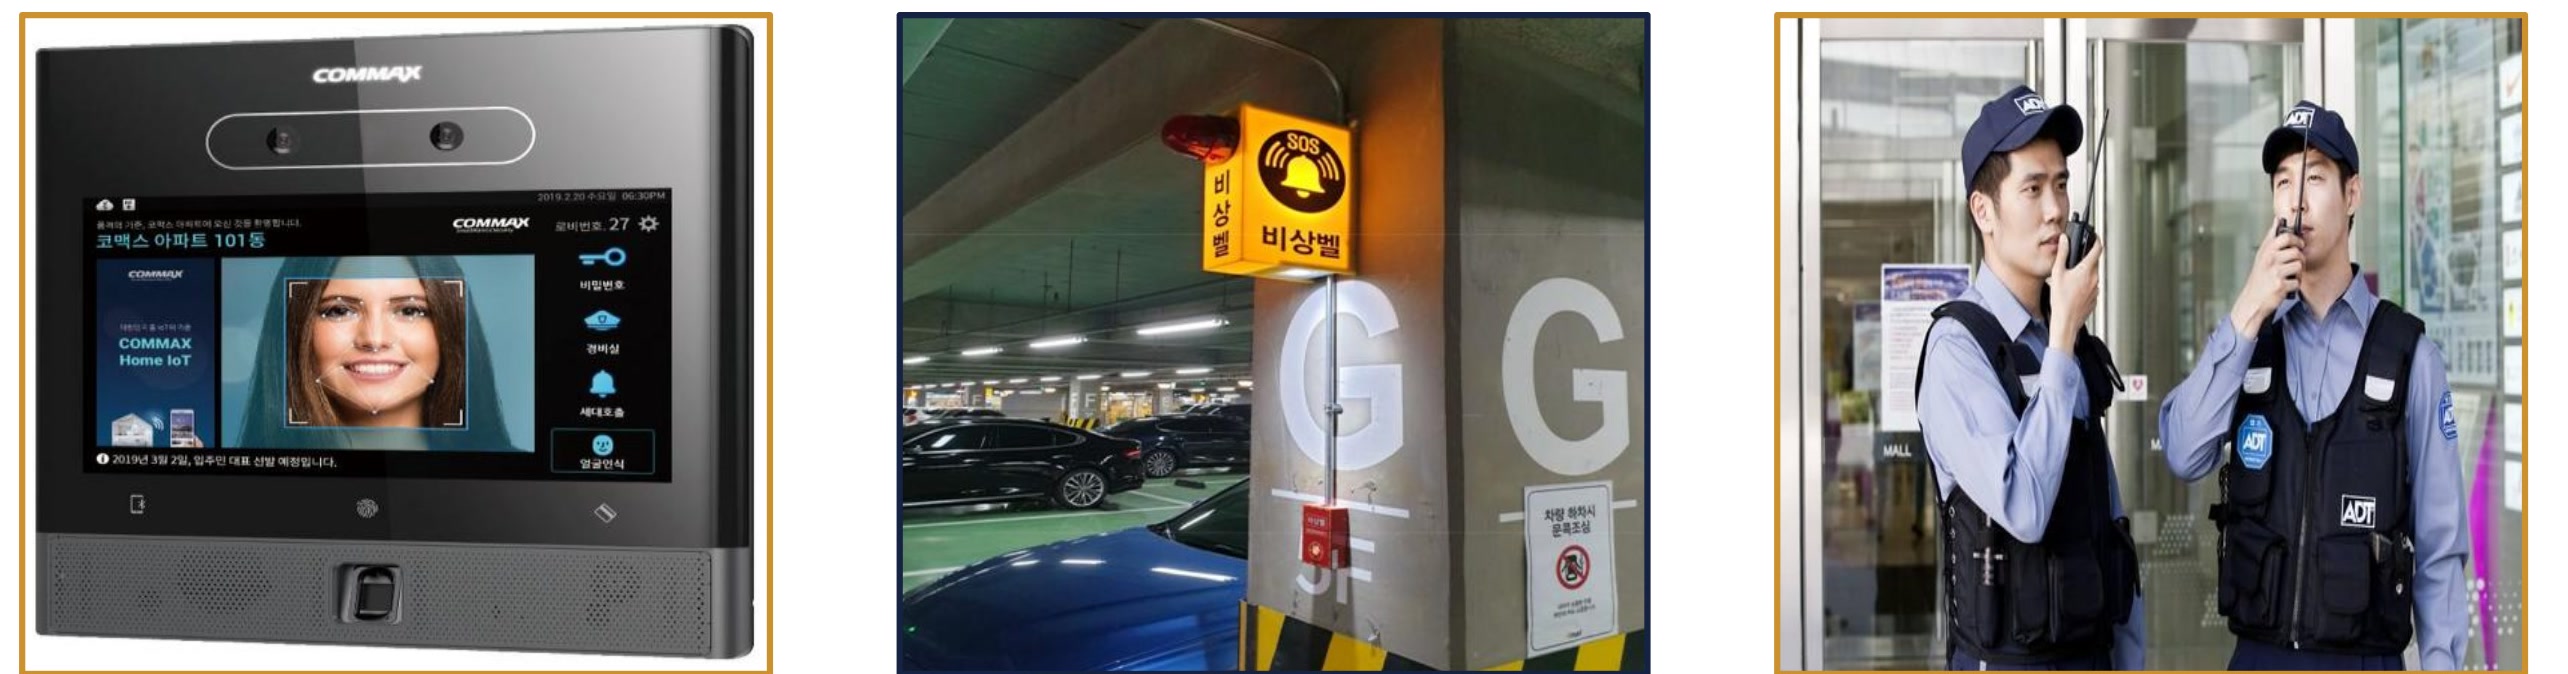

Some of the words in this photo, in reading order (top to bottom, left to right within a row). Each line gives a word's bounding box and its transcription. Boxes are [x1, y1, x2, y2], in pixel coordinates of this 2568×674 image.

[312, 66, 423, 83] COMMAX
[2285, 111, 2313, 126] ADT
[1286, 132, 1321, 155] SOS
[621, 191, 666, 200] 06:30PM
[1212, 169, 1231, 258] 비상벨
[453, 217, 530, 229] COMMAX
[609, 217, 630, 231] 27
[96, 233, 150, 250] 코맥스
[154, 233, 208, 249] 아파트
[214, 232, 266, 248] 101동
[1262, 225, 1340, 259] 비상벨
[128, 269, 184, 279] COMMAX
[580, 280, 626, 291] 비밀번호
[119, 338, 192, 349] COMMAX
[586, 343, 620, 355] 경비실
[120, 354, 163, 366] Home
[167, 354, 192, 366] IoT
[1279, 279, 1404, 472] G
[1501, 276, 1631, 477] G
[580, 407, 625, 418] 세대호출
[2243, 432, 2266, 451] ADT
[1883, 444, 1912, 457] MALL
[112, 454, 149, 466] 2019년
[151, 454, 168, 466] 3월
[171, 454, 191, 467] 2일,
[193, 454, 226, 466] 입주민
[228, 455, 250, 467] 대표
[277, 456, 338, 468] 예정입니다.
[580, 459, 625, 471] 얼굴인식
[1544, 507, 1565, 522] 차량
[1567, 504, 1596, 519] 하차시
[2343, 500, 2375, 524] ADT
